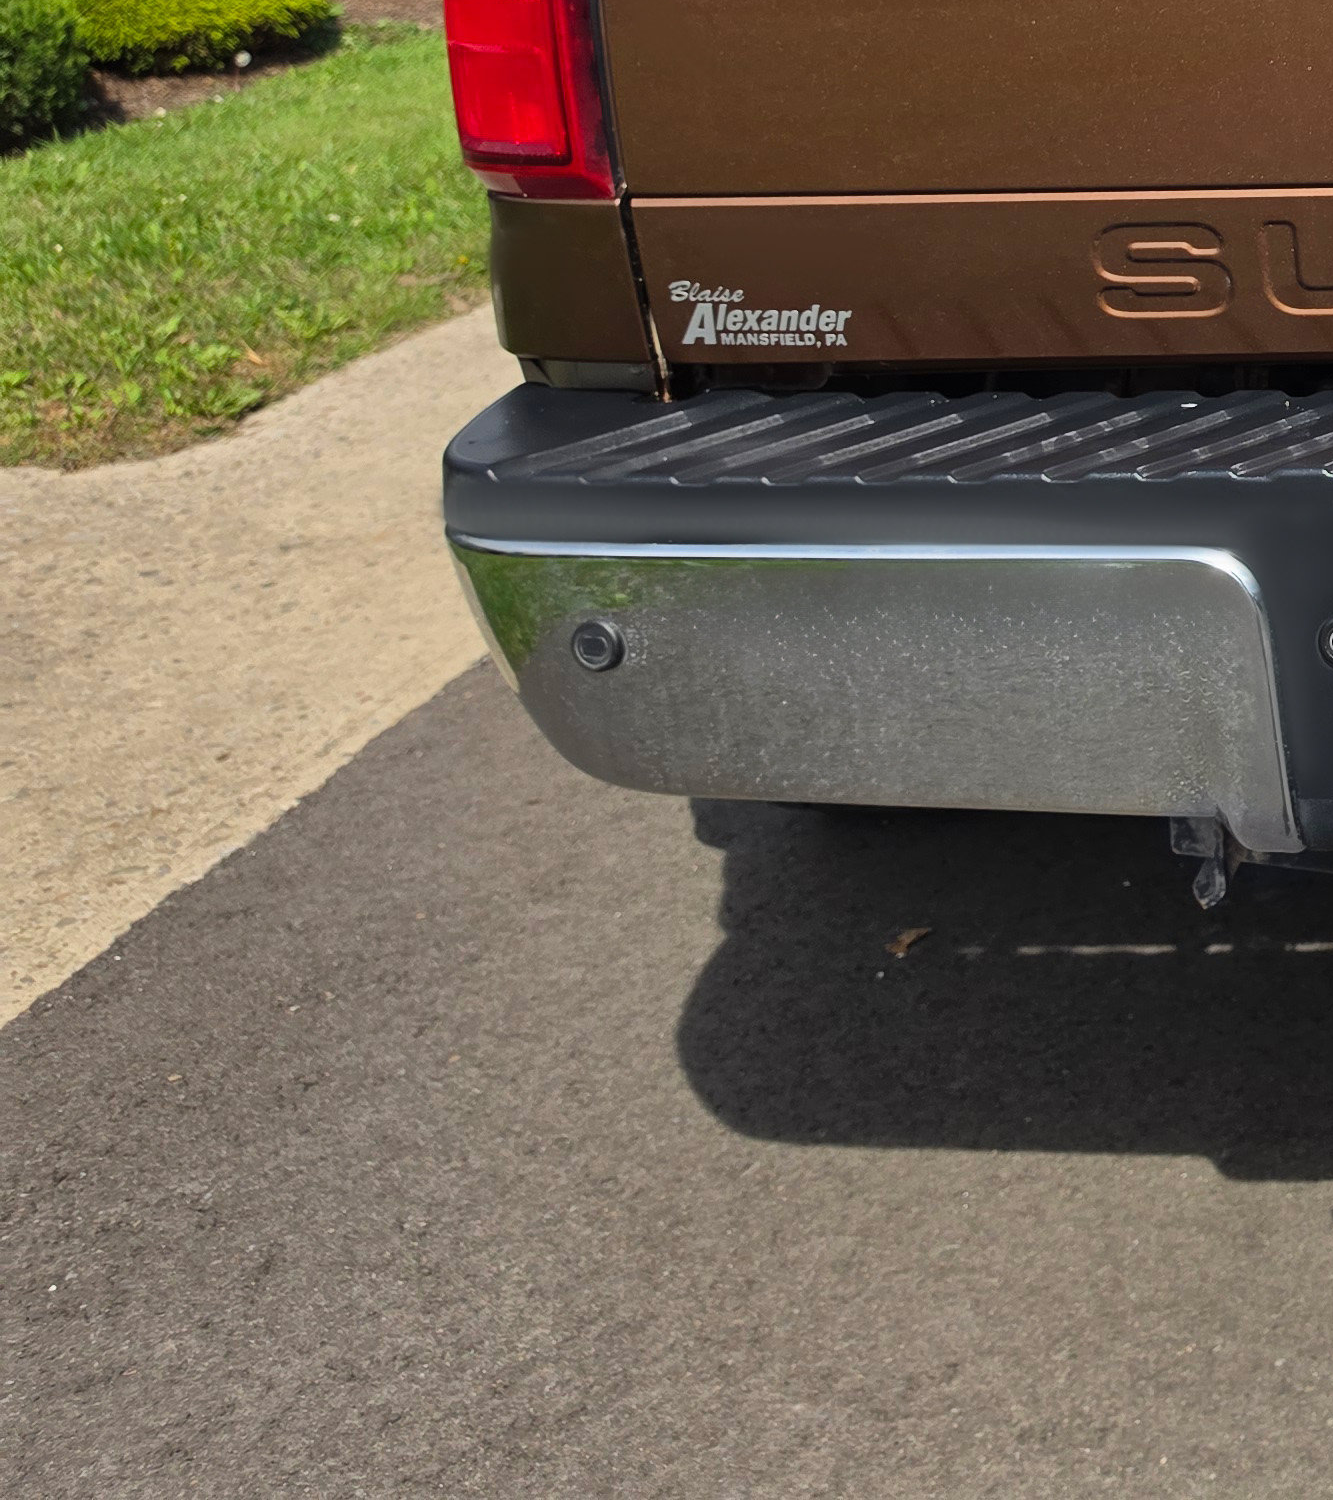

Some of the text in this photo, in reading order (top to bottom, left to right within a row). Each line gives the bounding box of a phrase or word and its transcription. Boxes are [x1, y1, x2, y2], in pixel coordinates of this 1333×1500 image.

[668, 280, 745, 302] Blaise
[682, 302, 852, 345] Alexander
[720, 333, 848, 348] MANSFIELD, PA
